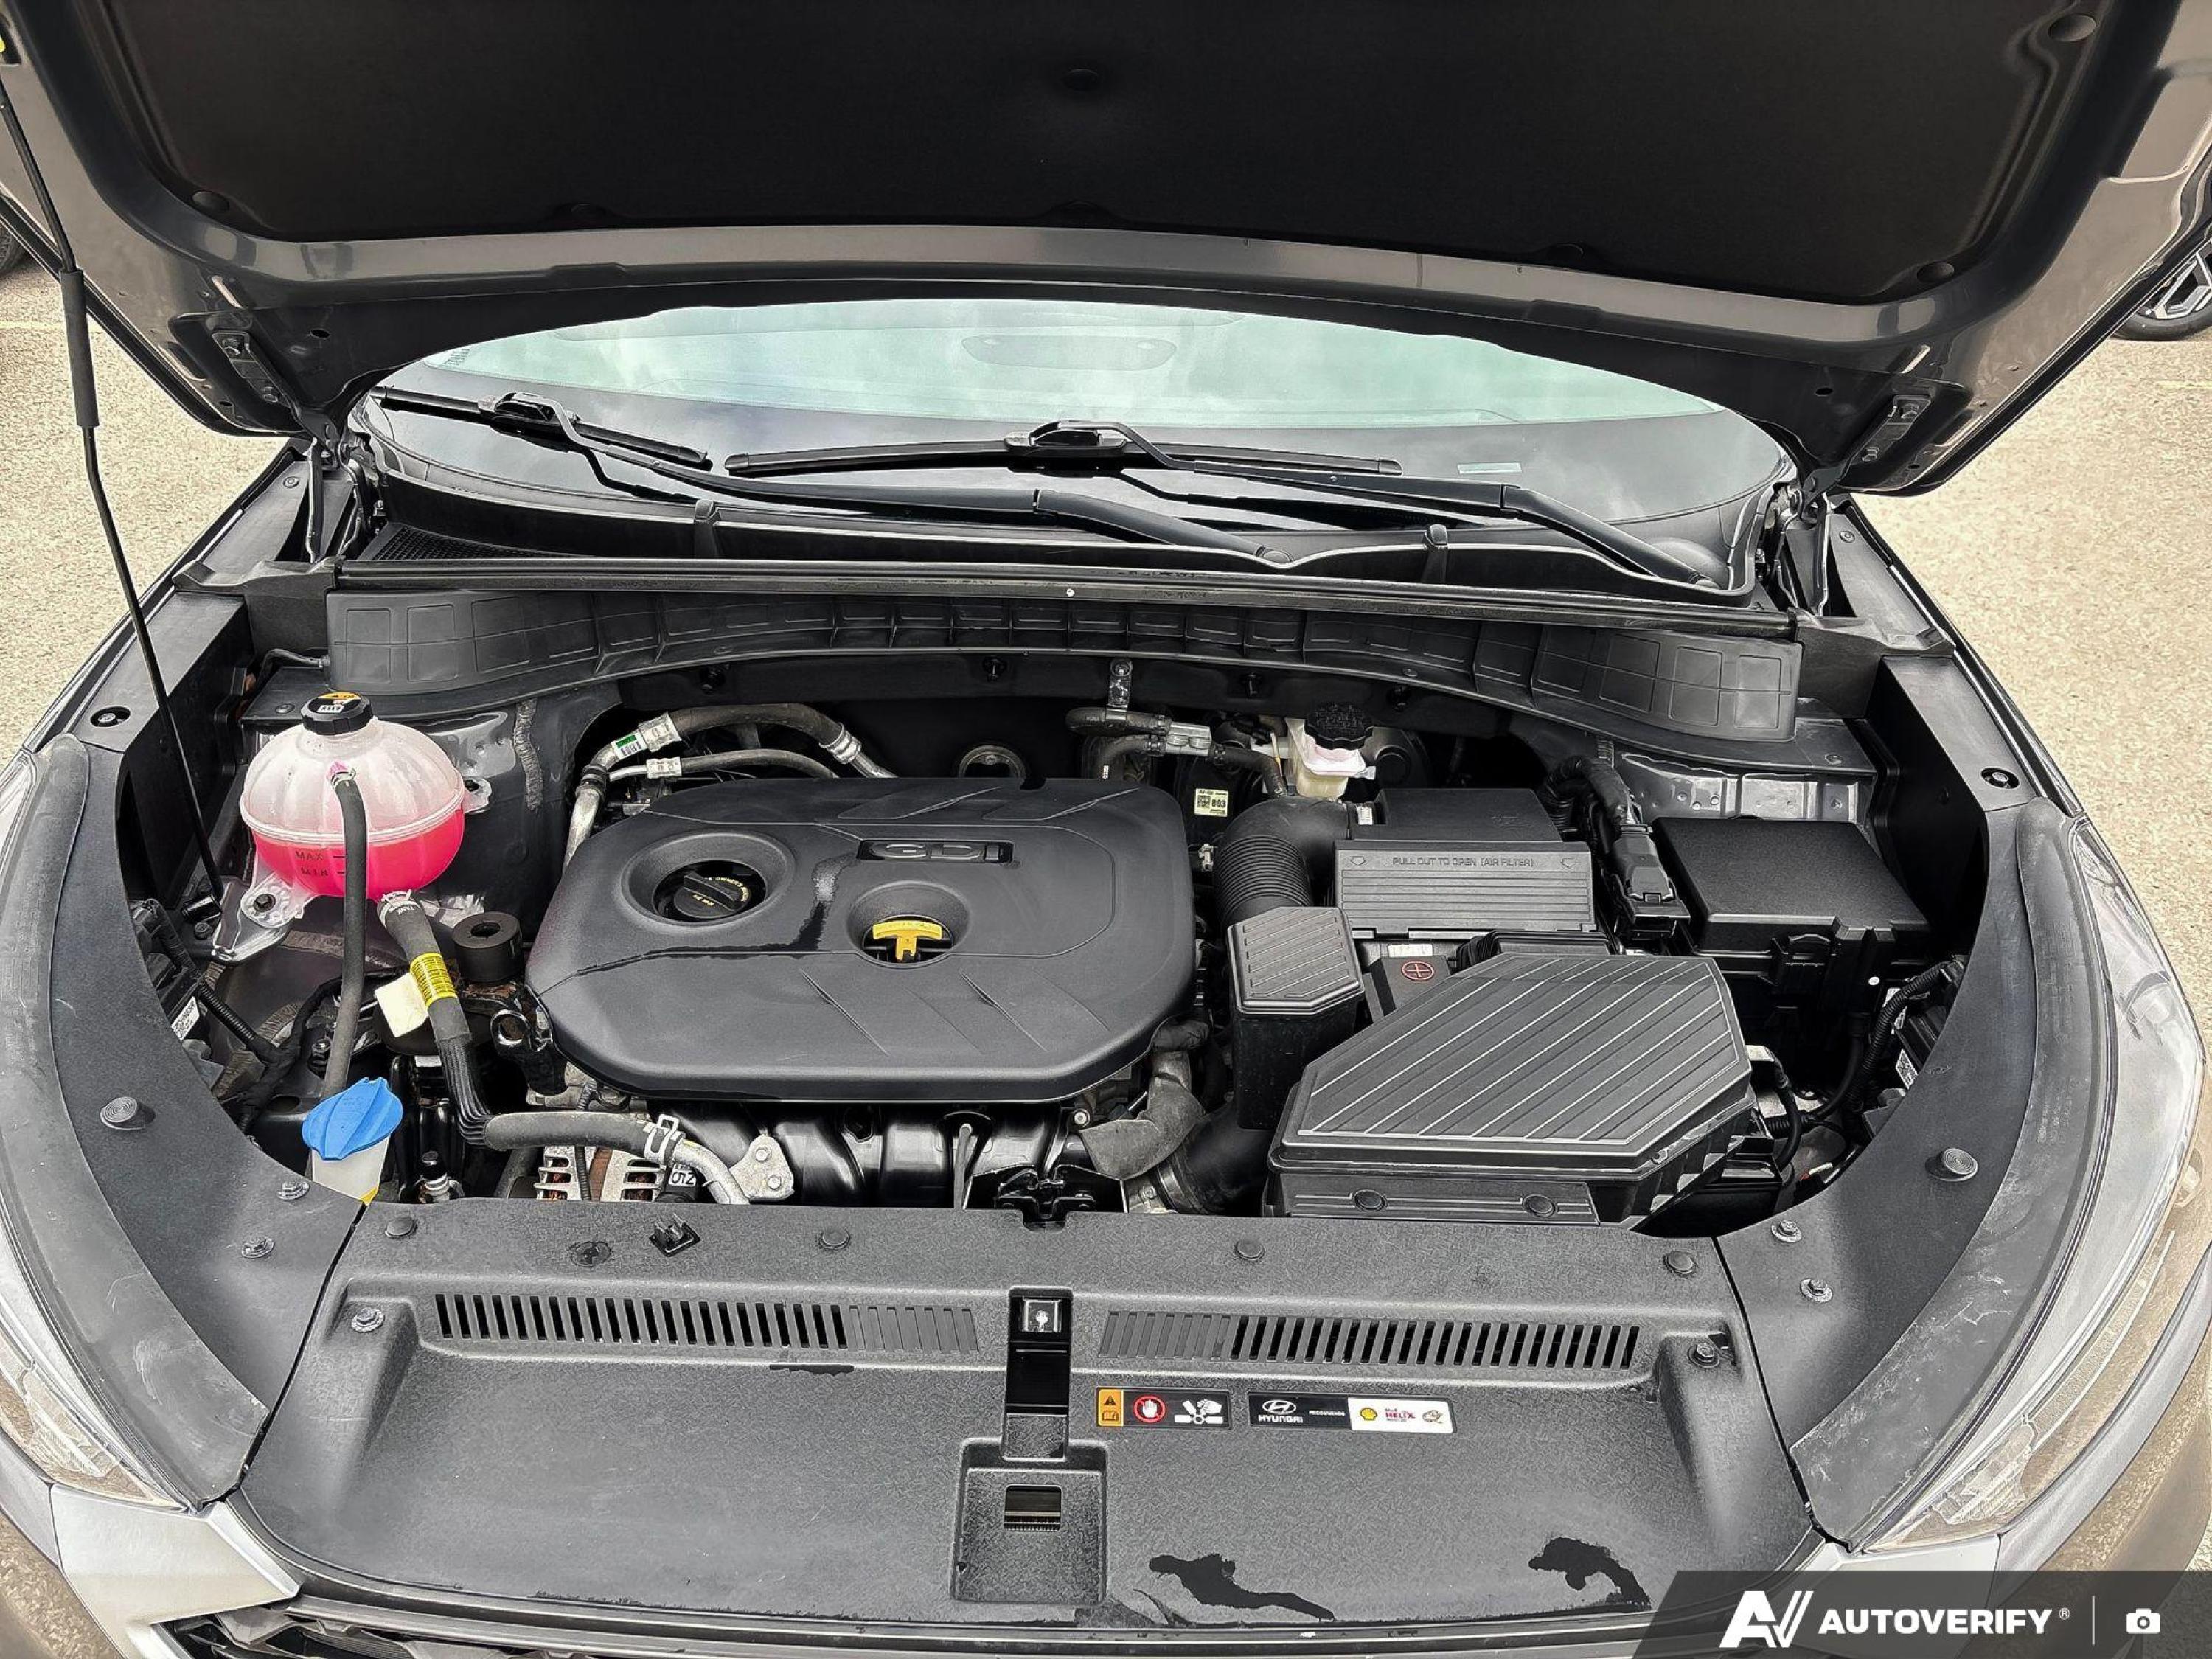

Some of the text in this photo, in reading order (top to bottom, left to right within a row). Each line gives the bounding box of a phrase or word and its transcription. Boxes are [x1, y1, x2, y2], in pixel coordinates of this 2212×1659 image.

[295, 851, 323, 860] MAX
[1392, 856, 1416, 866] PULL
[1416, 857, 1436, 866] OUT
[1437, 857, 1450, 866] TO
[1452, 857, 1476, 867] OPEN
[301, 867, 329, 877] MIN
[1258, 1414, 1304, 1424] HYUNDAI
[1385, 1411, 1416, 1419] HELIX
